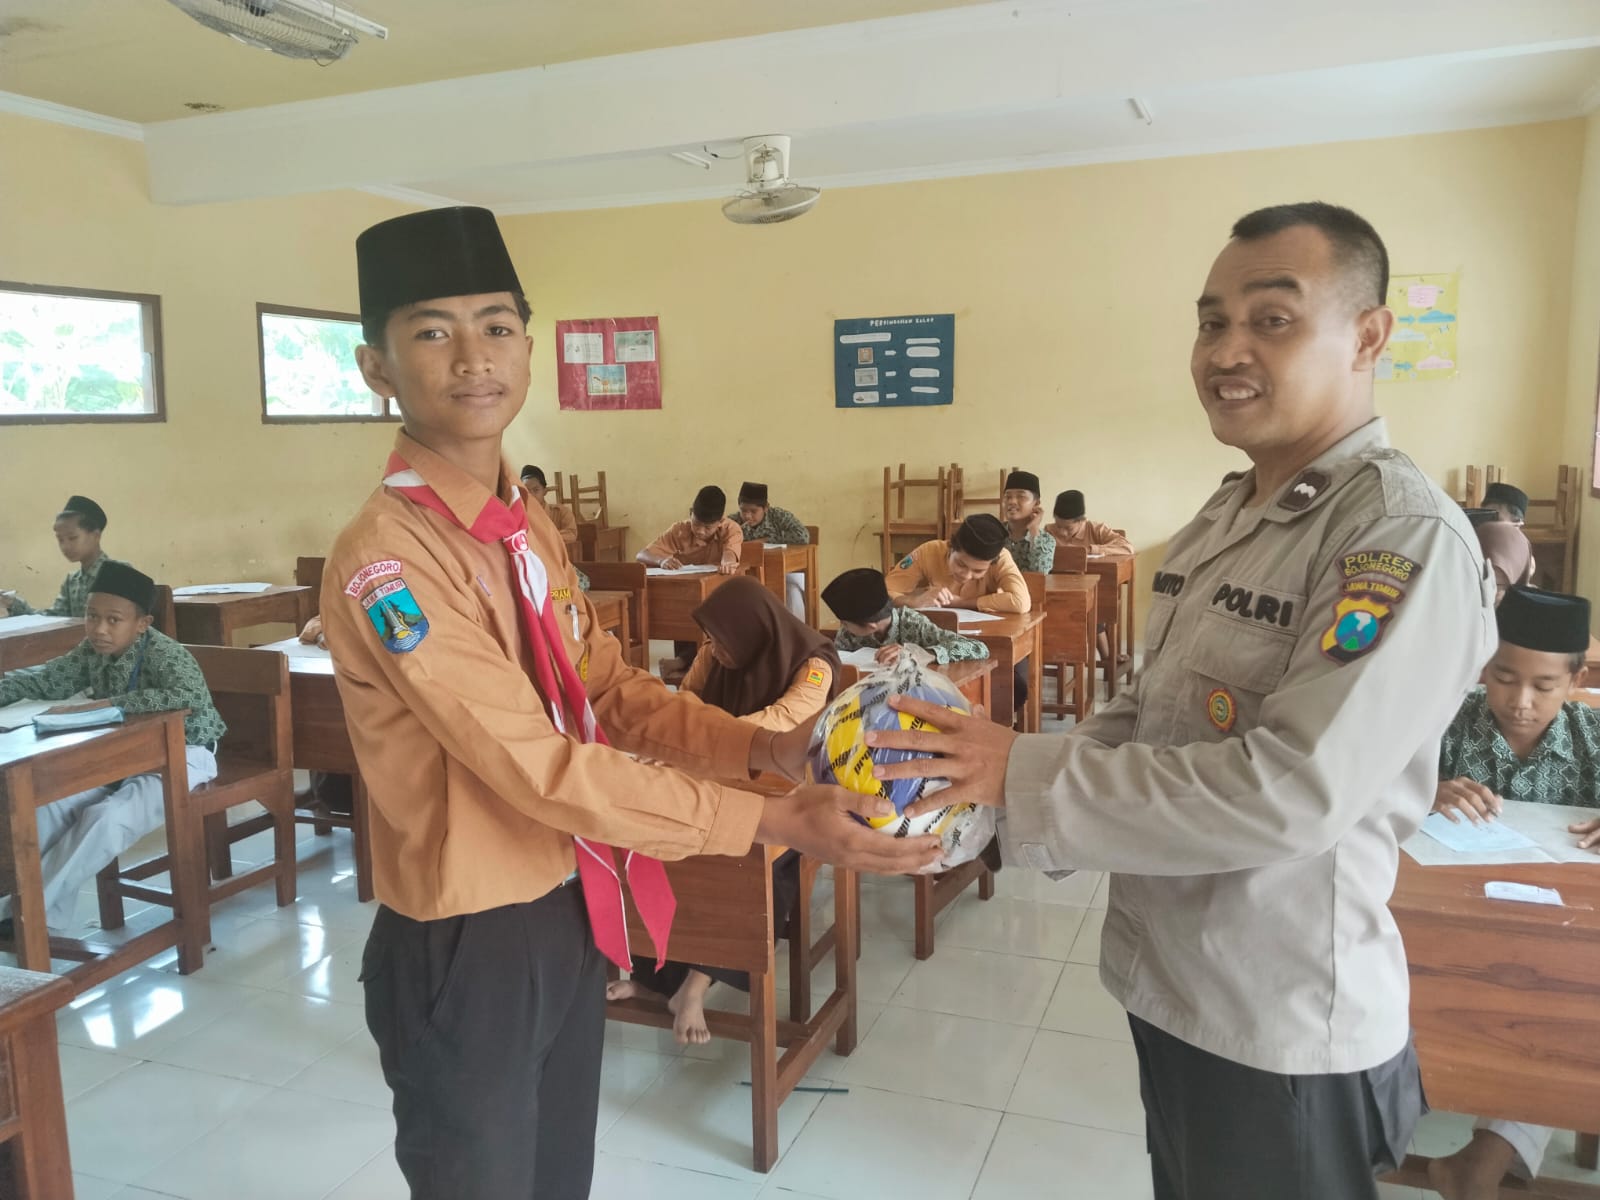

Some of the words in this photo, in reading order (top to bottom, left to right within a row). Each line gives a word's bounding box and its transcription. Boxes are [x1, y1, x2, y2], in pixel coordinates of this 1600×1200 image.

[1344, 561, 1409, 581] BOJONEGORO
[1345, 552, 1414, 572] POLRES
[349, 562, 400, 594] BOJONEGORO
[550, 587, 572, 600] PRAM
[1369, 582, 1400, 599] TIMUR
[1212, 584, 1293, 627] POLRI
